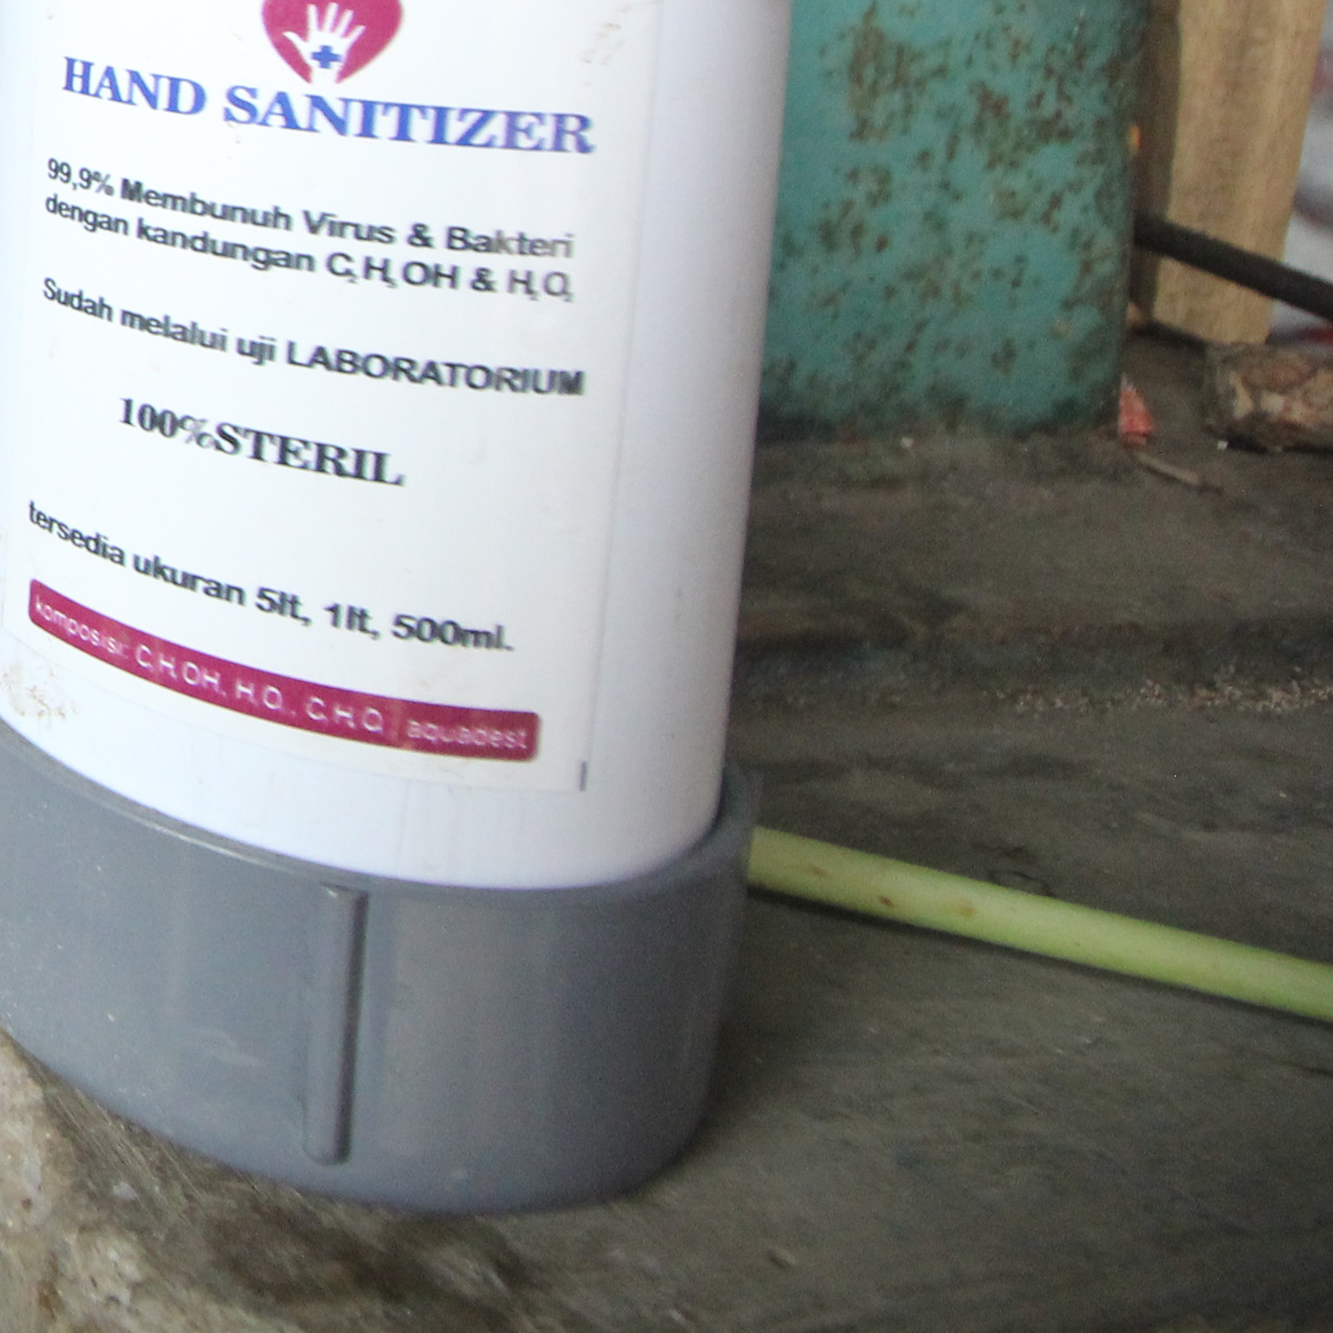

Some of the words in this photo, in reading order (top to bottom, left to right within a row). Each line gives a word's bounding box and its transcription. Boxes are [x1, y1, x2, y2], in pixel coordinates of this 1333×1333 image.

[62, 56, 206, 115] HAND
[222, 85, 596, 155] SANITIZER
[45, 193, 129, 233] dengan
[136, 217, 316, 271] kandungan
[469, 267, 497, 293] &
[47, 157, 115, 196] 99,9%
[120, 178, 293, 231] Membunuh
[302, 209, 396, 245] Virus
[407, 222, 435, 249] &
[446, 225, 575, 258] Bakteri
[43, 277, 113, 322] Sudah
[120, 308, 229, 353] melalui
[236, 335, 278, 366] uji
[287, 340, 586, 396] LABORATORIUM
[29, 500, 126, 567] tersedia
[133, 554, 246, 606] ukuran
[255, 585, 313, 627] 5lt,
[323, 602, 382, 641] 1lt,
[390, 612, 515, 652] 500ml.
